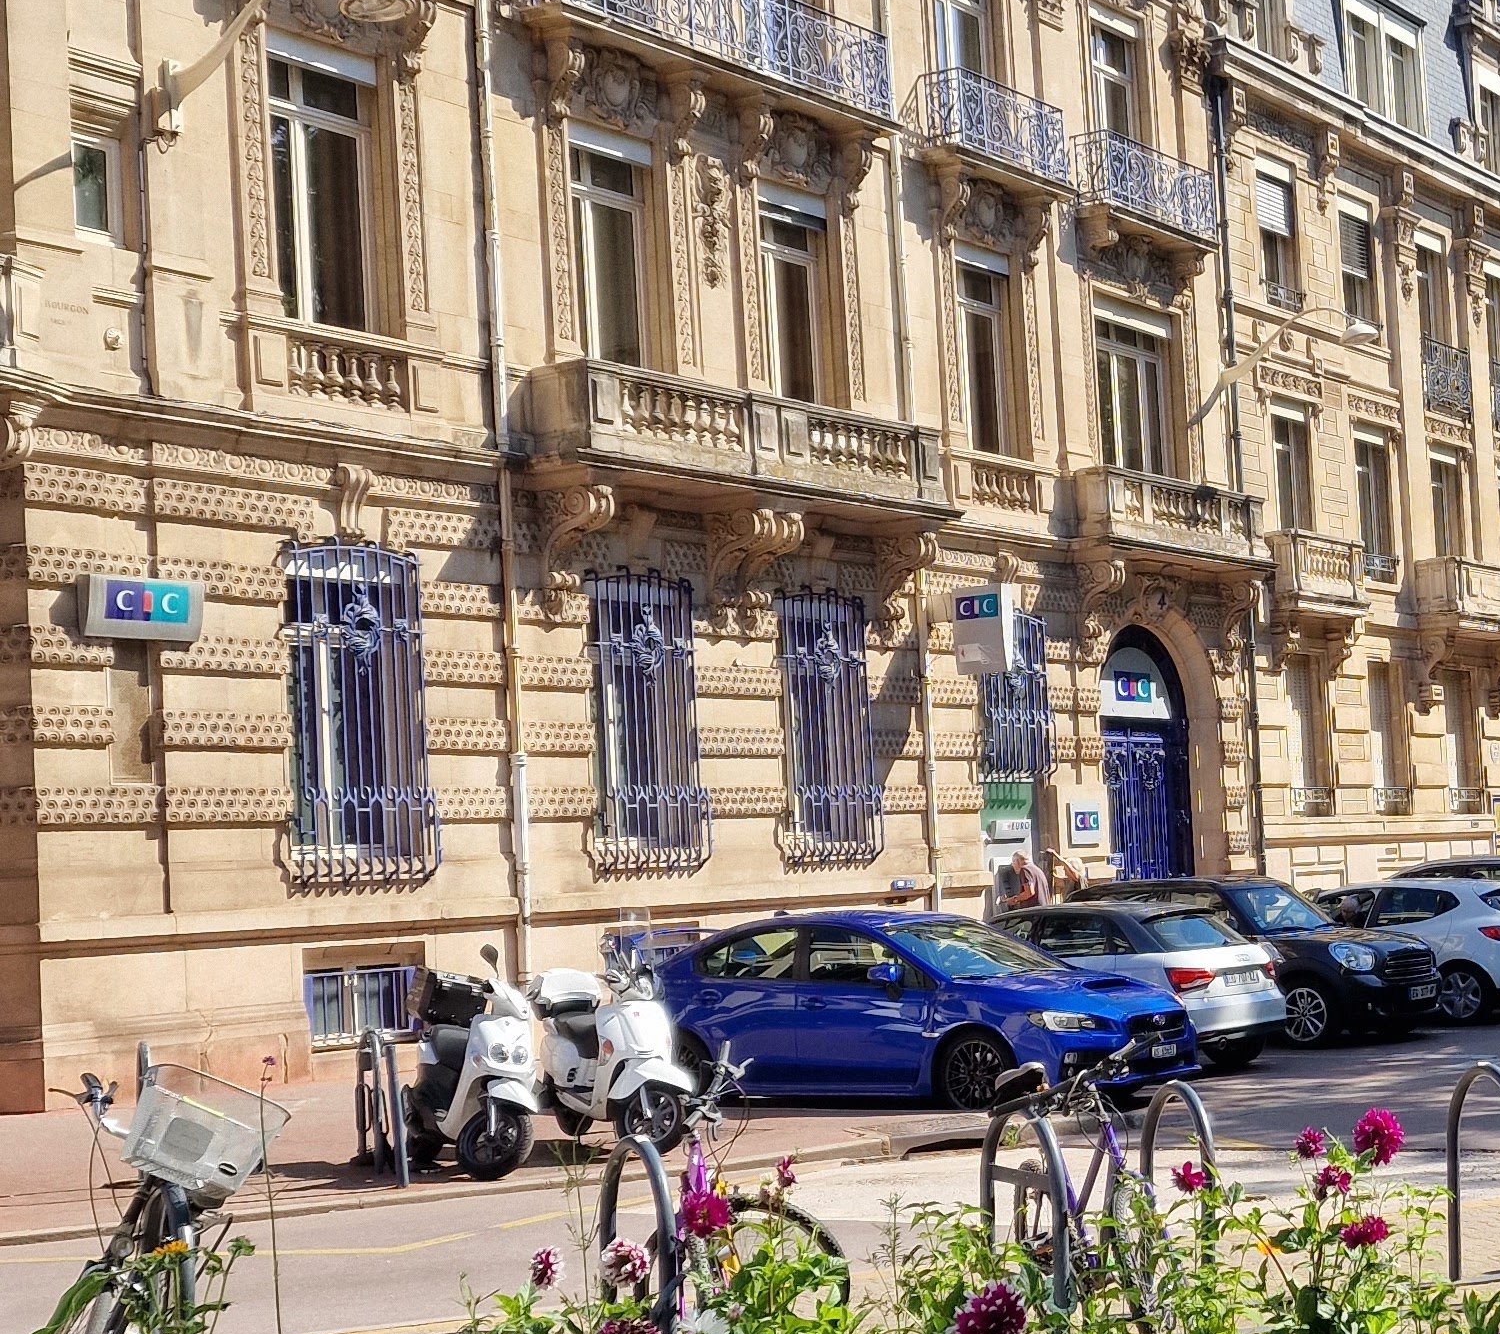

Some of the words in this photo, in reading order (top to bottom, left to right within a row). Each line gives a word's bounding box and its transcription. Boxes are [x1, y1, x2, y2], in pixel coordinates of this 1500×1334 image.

[116, 589, 179, 614] CIC
[959, 598, 995, 616] CIC
[1157, 593, 1167, 610] 4
[1117, 677, 1149, 698] CIC
[1076, 814, 1098, 828] CIC
